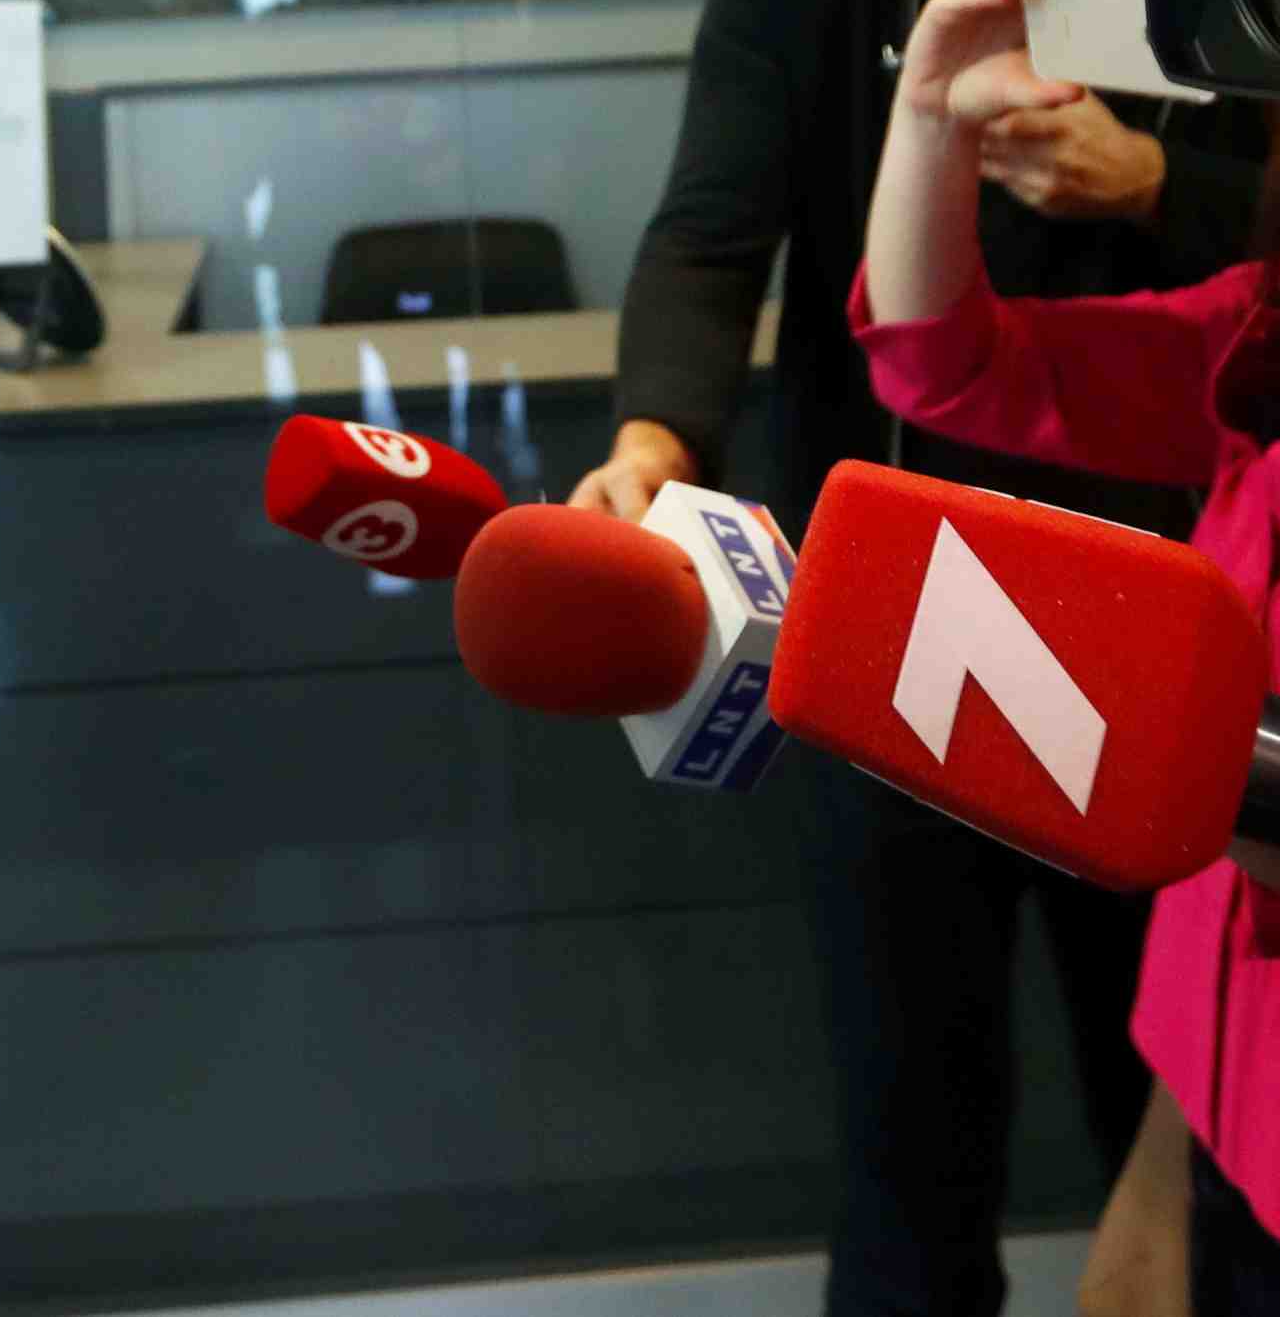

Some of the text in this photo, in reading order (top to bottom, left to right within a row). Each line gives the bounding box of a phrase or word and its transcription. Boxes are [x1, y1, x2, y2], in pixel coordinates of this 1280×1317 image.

[351, 424, 424, 471] 3
[330, 508, 412, 557] 3
[708, 516, 784, 614] LNT
[892, 516, 1108, 818] 7
[684, 669, 763, 773] LNT
